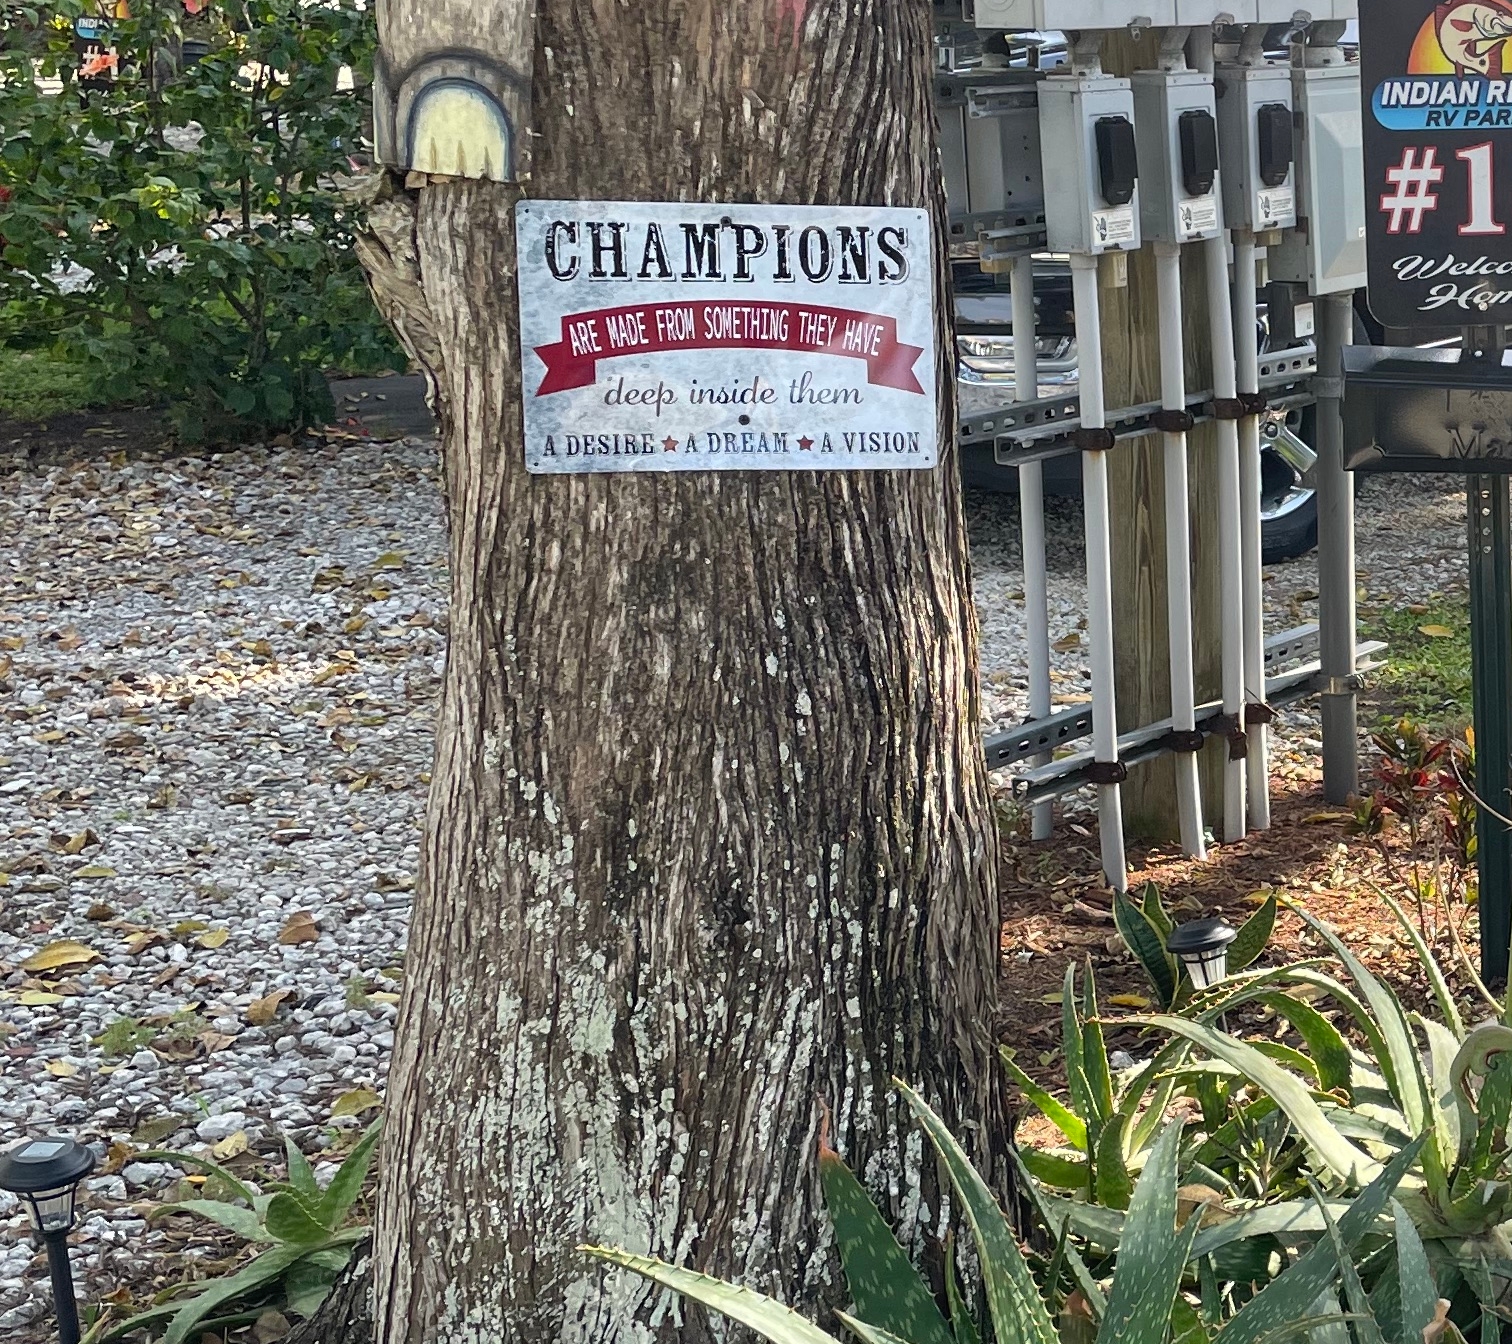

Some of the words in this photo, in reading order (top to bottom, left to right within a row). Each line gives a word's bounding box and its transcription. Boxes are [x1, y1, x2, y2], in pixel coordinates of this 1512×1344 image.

[1381, 81, 1480, 109] INDIAN
[1426, 110, 1461, 127] RV
[544, 220, 911, 284] CHAMPIONS
[569, 319, 603, 357] ARE
[606, 312, 649, 349] MADE
[655, 308, 695, 342] FROM
[703, 306, 789, 342] SOMETHING
[798, 311, 837, 346] THEY
[843, 320, 884, 357] HAVE
[604, 376, 677, 417] deep
[690, 376, 777, 405] inside
[788, 371, 863, 405] them
[544, 434, 555, 457] A
[566, 434, 655, 457] DESIRE
[685, 433, 698, 455] A
[707, 432, 789, 454] DREAM
[821, 432, 833, 453] A
[842, 431, 921, 455] VISION
